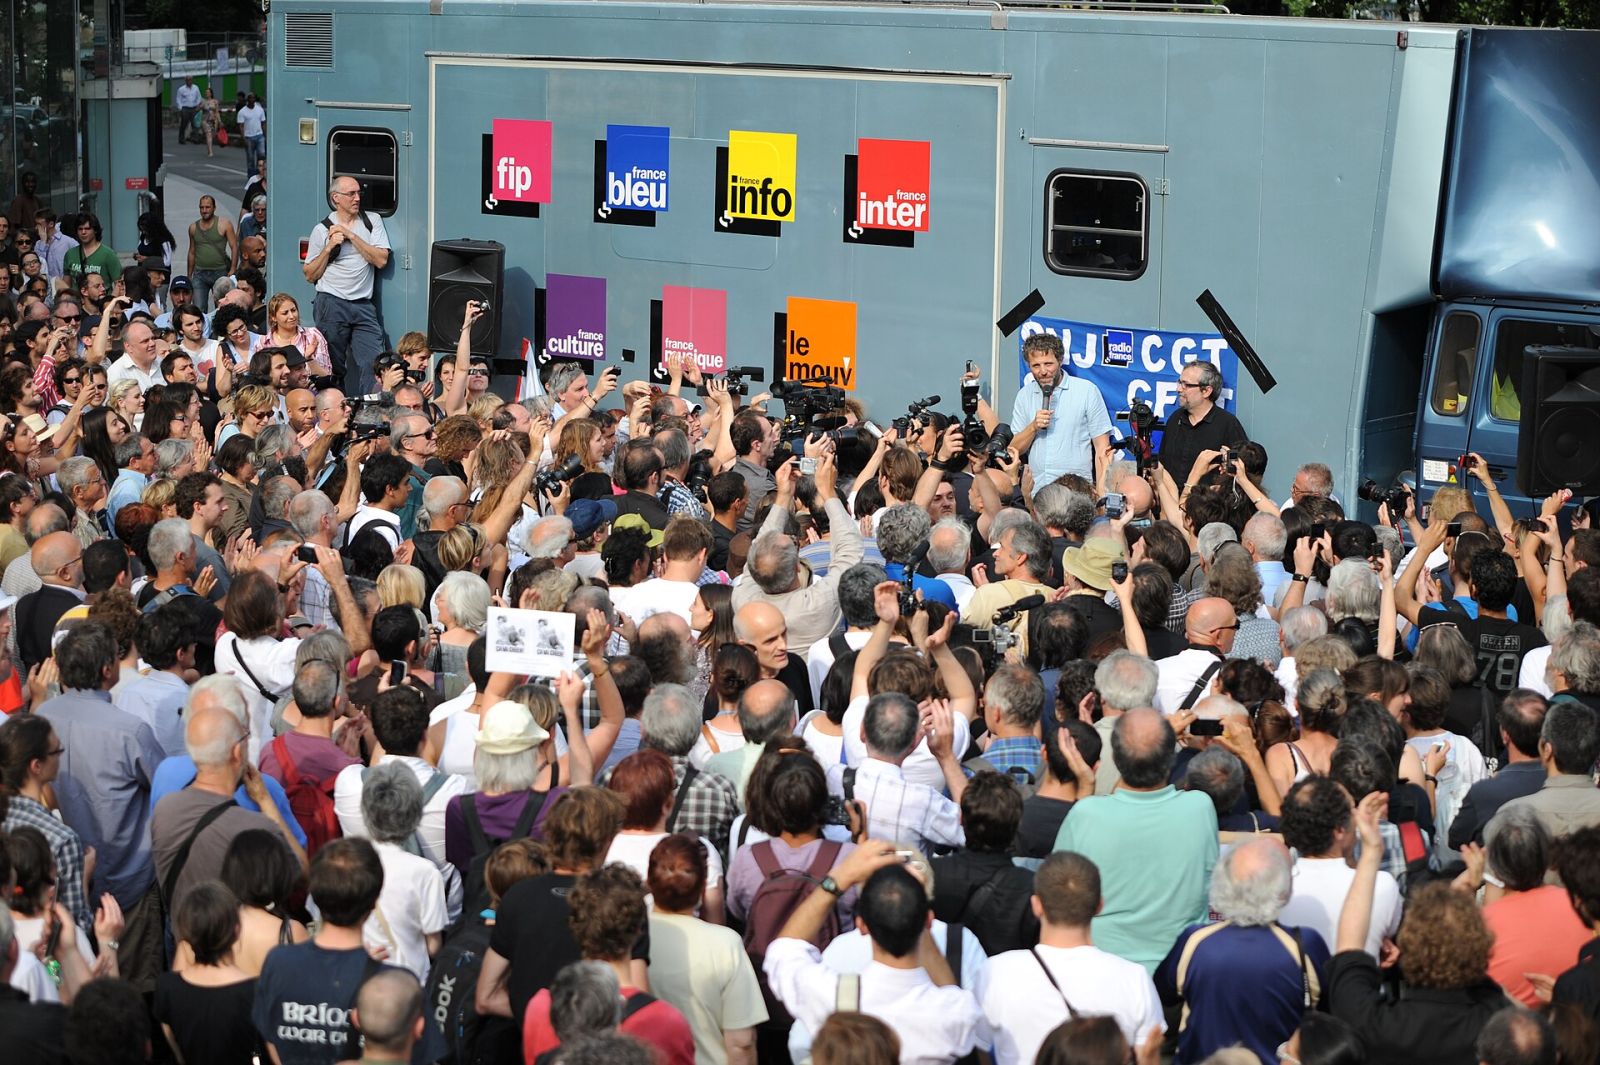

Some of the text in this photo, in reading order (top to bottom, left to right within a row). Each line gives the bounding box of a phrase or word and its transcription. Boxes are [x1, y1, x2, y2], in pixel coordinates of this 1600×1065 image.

[497, 157, 532, 198] fip
[632, 166, 666, 180] france
[739, 176, 760, 185] france
[608, 172, 666, 208] bleu
[731, 175, 792, 217] info
[896, 189, 926, 201] france
[860, 192, 926, 228] inter
[549, 335, 604, 357] culture
[578, 329, 603, 341] france
[665, 338, 694, 350] france
[790, 330, 810, 356] le
[1108, 342, 1132, 353] radio
[1109, 351, 1132, 361] france
[1141, 335, 1228, 375] CGT
[1475, 652, 1520, 690] 78
